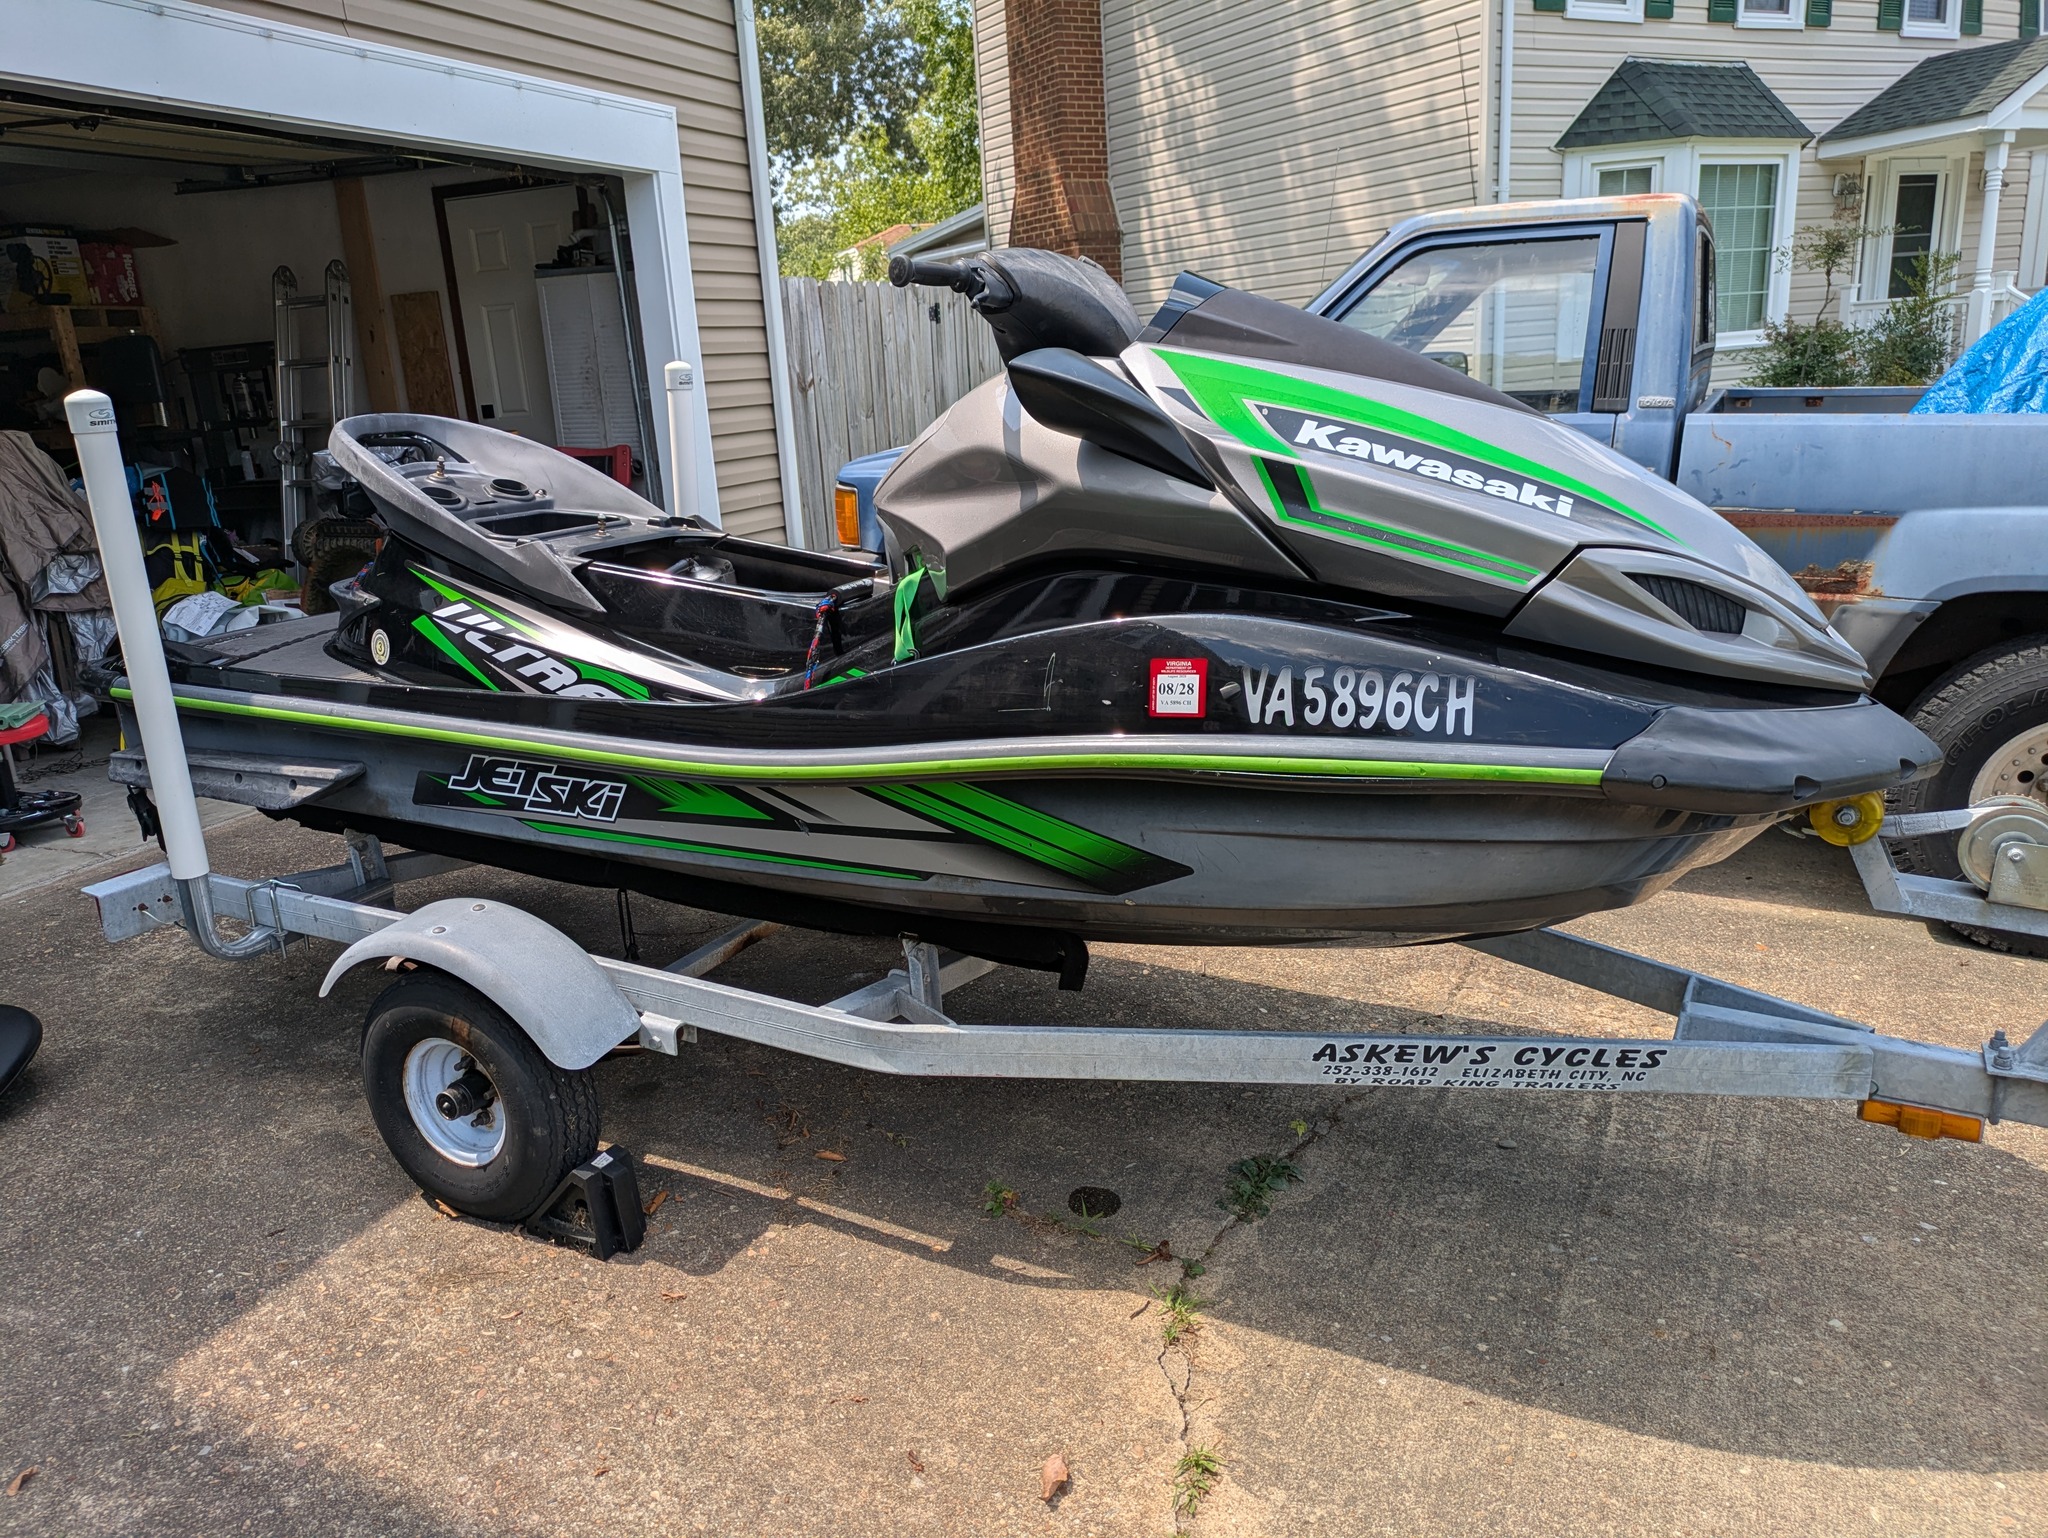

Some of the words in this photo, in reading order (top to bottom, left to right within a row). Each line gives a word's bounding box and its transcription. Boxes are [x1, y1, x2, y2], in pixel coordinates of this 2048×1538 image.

[1638, 398, 1676, 408] TOYOTA
[1294, 419, 1574, 518] Kawasaki
[1158, 682, 1195, 696] 08/28
[1242, 665, 1295, 726] VA
[1312, 1043, 1497, 1065] ASKEW'S
[1513, 1046, 1668, 1069] CYCLES
[1322, 1065, 1439, 1077] 252-338-1612
[1461, 1068, 1562, 1080] ELIZABETH
[1569, 1070, 1612, 1083] CITY,
[1621, 1072, 1647, 1081] NC
[1371, 1078, 1433, 1086] ROAD
[1443, 1079, 1500, 1087] KING
[1513, 1080, 1621, 1090] TRAILERS
